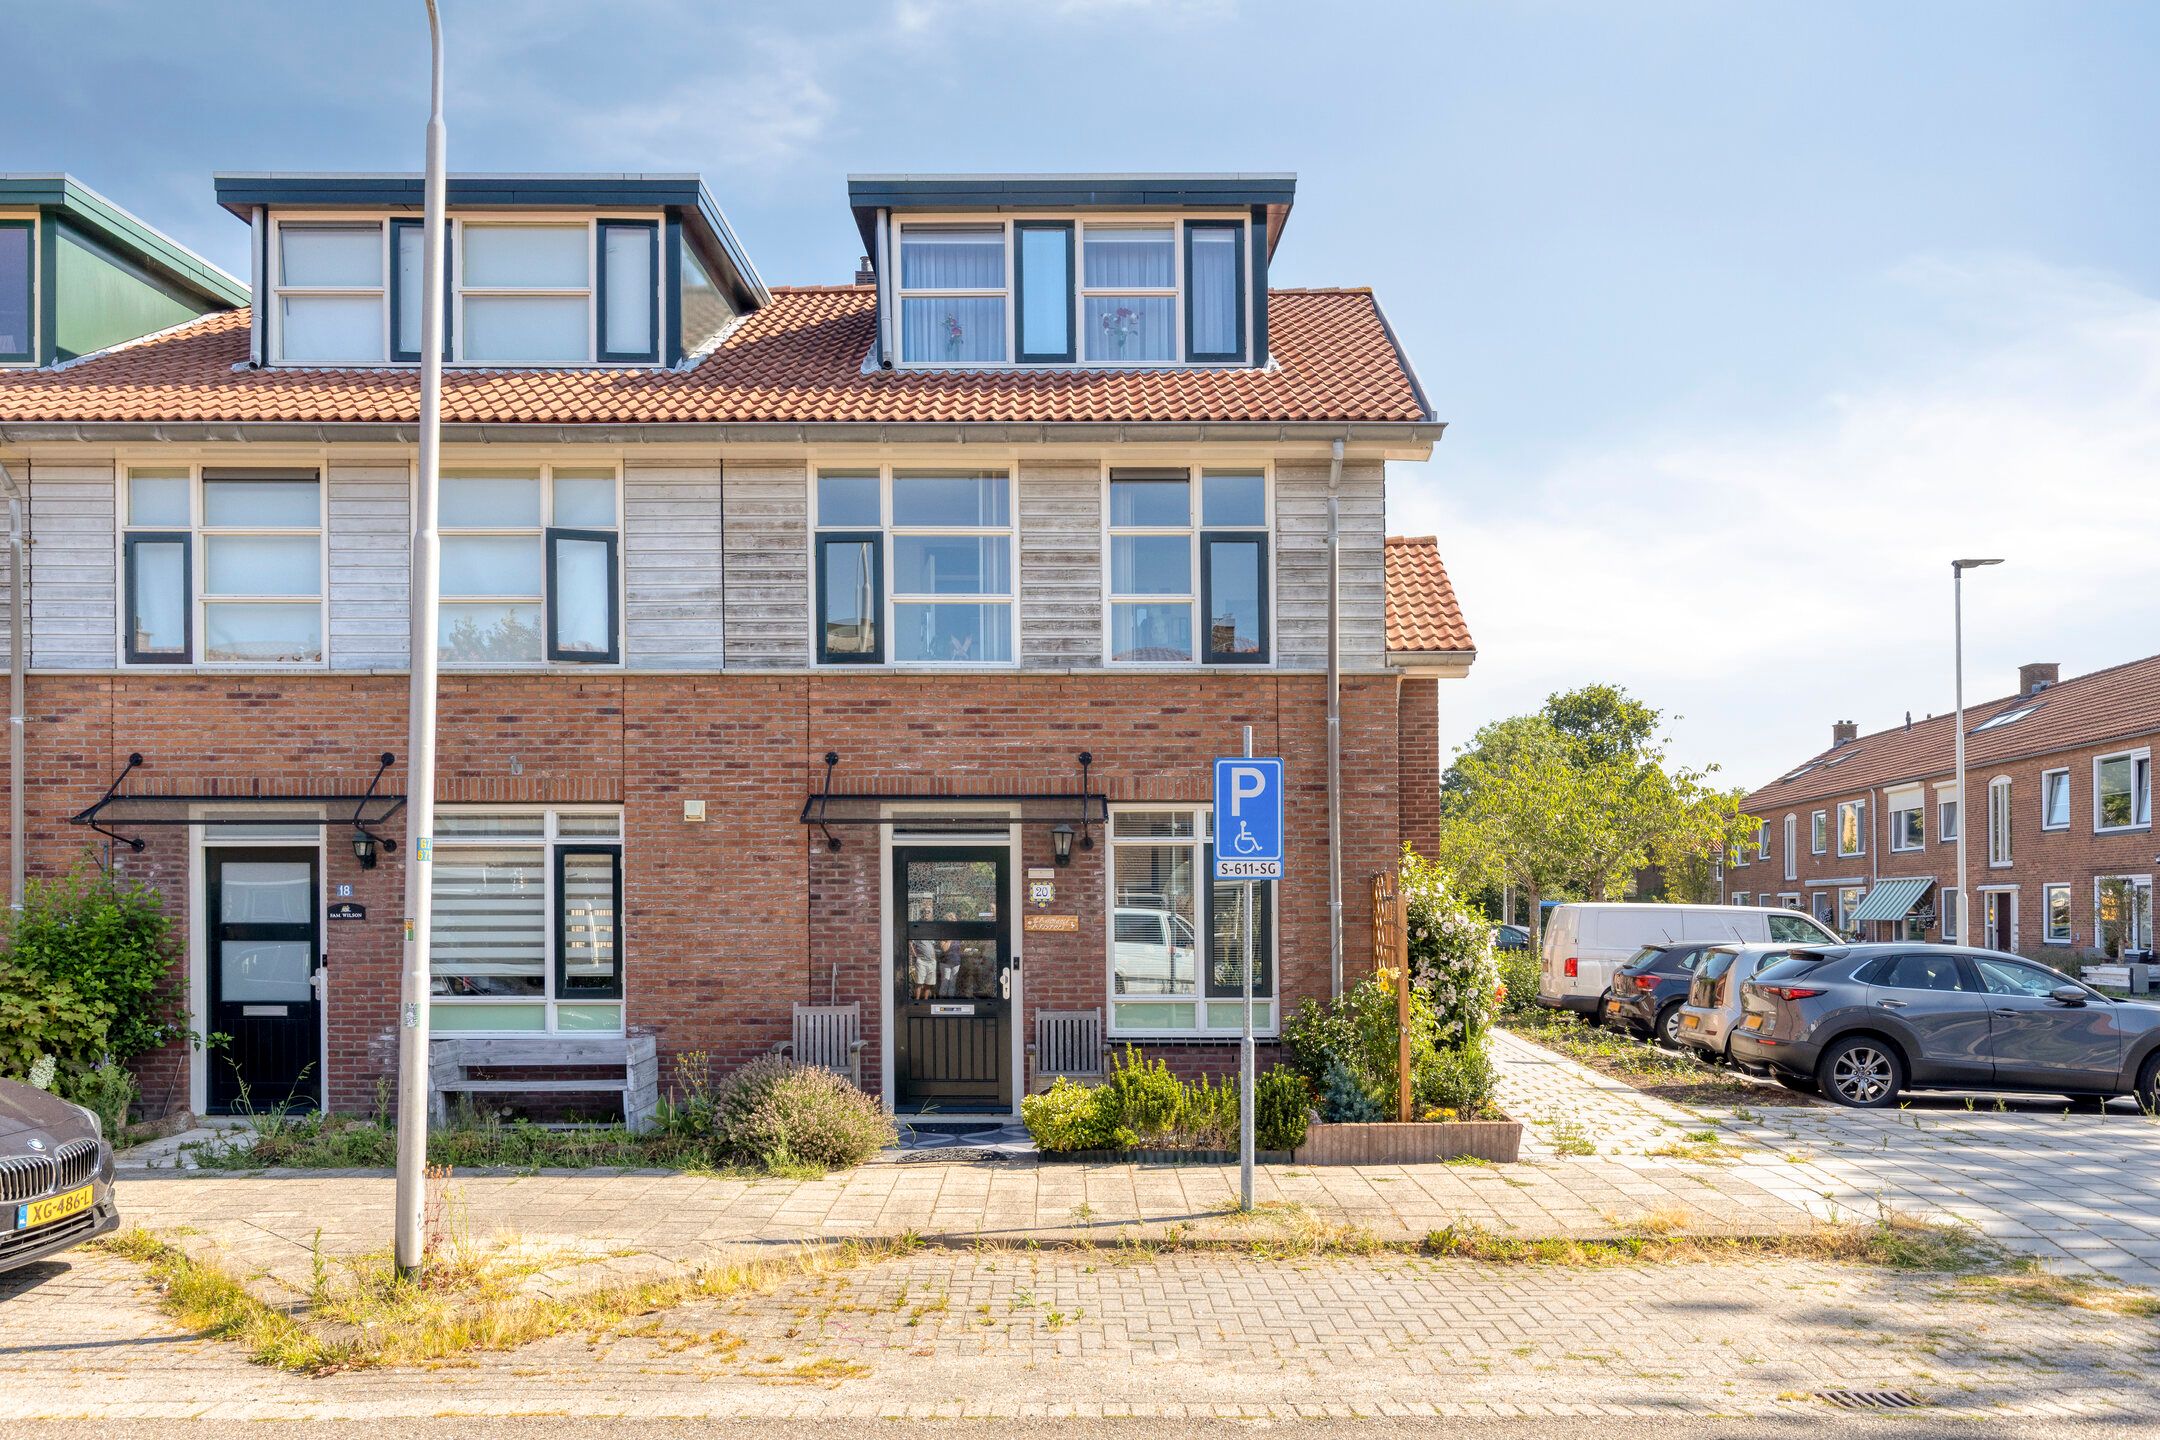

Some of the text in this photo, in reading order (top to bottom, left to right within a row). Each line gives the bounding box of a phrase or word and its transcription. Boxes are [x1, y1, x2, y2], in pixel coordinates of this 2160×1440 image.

[1231, 767, 1266, 817] P
[1221, 863, 1276, 875] S-611-SG
[339, 884, 351, 896] 18
[1035, 886, 1049, 897] 20
[32, 1190, 90, 1223] XG-486-L
